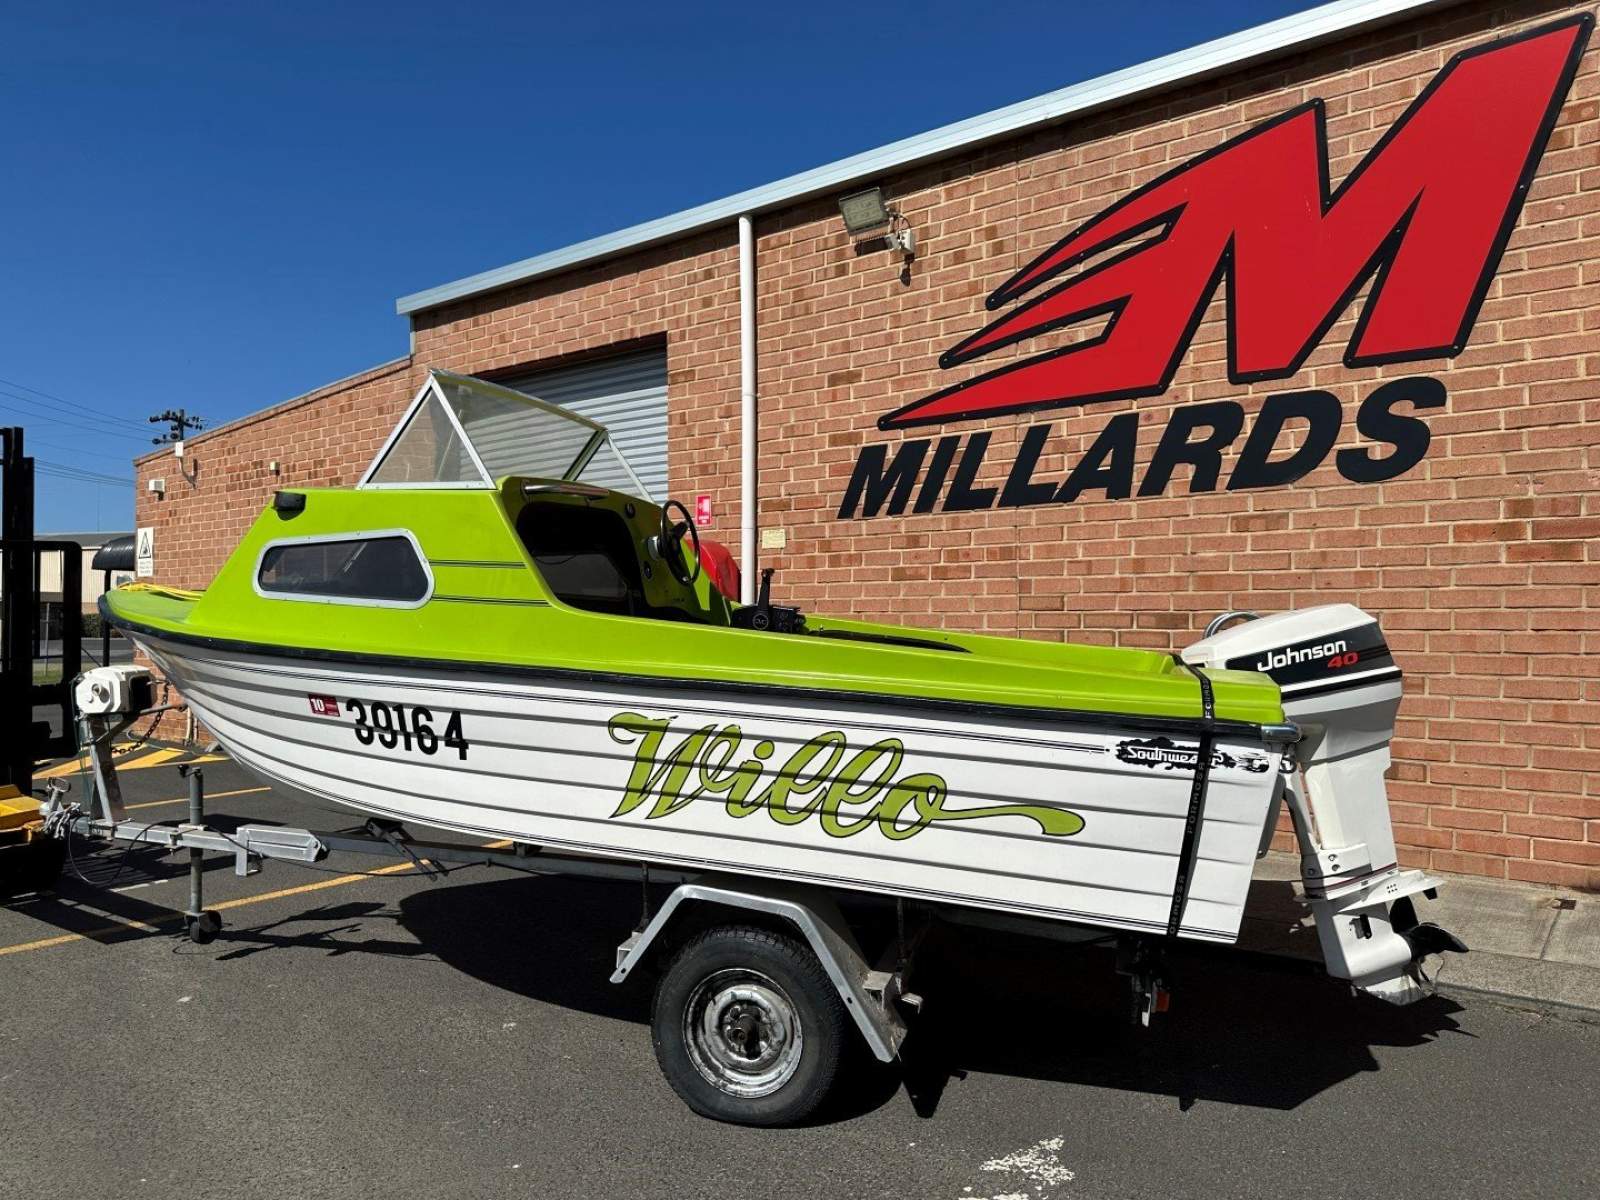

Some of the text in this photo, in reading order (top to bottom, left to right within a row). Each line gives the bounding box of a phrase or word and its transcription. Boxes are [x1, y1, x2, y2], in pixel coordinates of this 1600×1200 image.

[838, 376, 1447, 519] MILLARDS
[1257, 640, 1347, 672] Johnson
[1327, 651, 1360, 669] 40
[310, 698, 325, 712] 10
[346, 698, 469, 760] 39164
[608, 711, 1086, 841] Willo
[1168, 875, 1186, 935] ORMOSA
